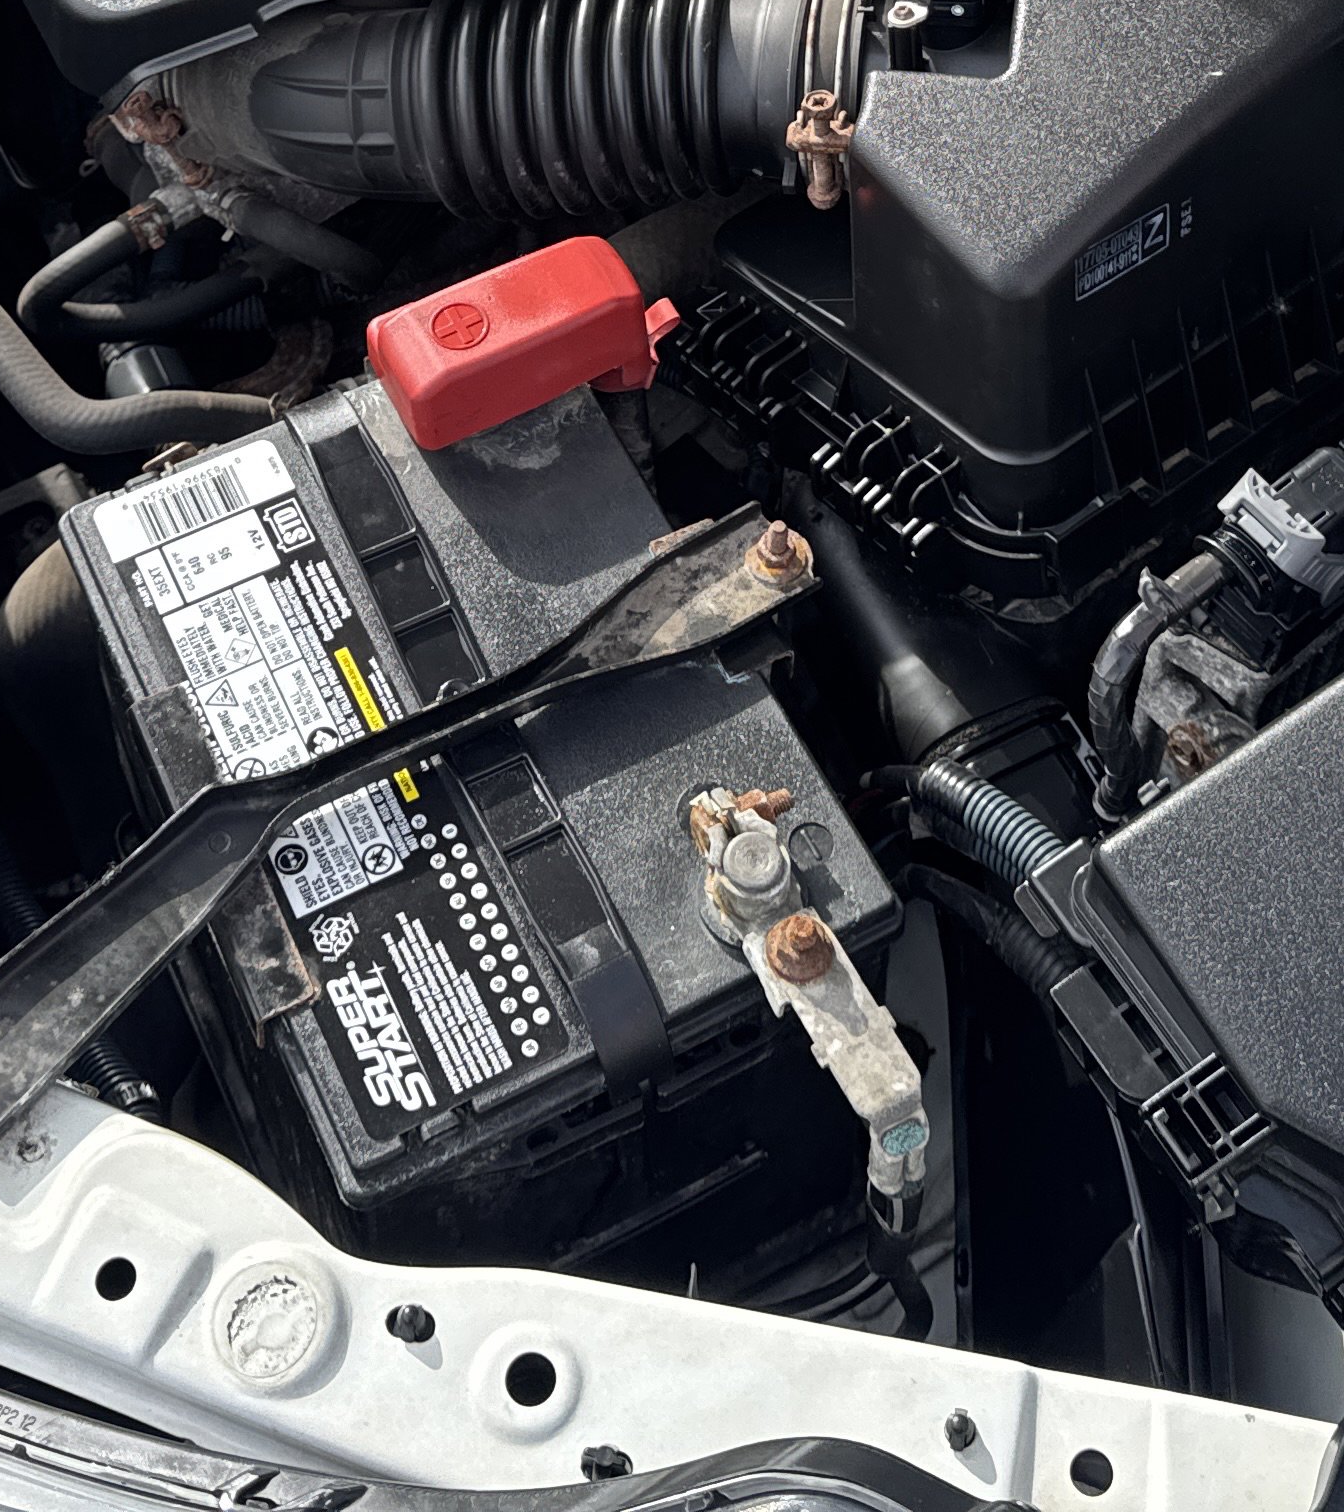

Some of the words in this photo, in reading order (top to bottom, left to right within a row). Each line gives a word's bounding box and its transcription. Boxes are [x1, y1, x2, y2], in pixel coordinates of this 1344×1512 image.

[1144, 213, 1164, 250] Z
[271, 503, 309, 547] STD
[247, 526, 265, 550] 12V
[217, 545, 233, 561] 95
[187, 554, 205, 576] 640
[147, 564, 171, 597] 35EXT
[181, 572, 196, 591] CCA
[198, 600, 213, 619] GET
[209, 596, 234, 633] MEDICAL
[231, 613, 249, 636] HELP
[255, 619, 271, 639] OPEN
[175, 635, 192, 658] EYES
[183, 624, 216, 680] IMMEDIATELY
[264, 638, 278, 654] NOT
[273, 633, 288, 650] NOT
[209, 651, 227, 674] WITH
[271, 653, 283, 665] DO
[281, 648, 293, 661] DO
[185, 657, 205, 685] FLUSH
[247, 682, 260, 695] OR
[289, 690, 303, 706] ALL
[241, 698, 260, 724] CAUSE
[253, 693, 278, 735] BLINDNESS
[269, 701, 290, 730] SEVERE
[295, 704, 312, 726] READ
[216, 708, 243, 751] SULFURIC
[238, 722, 256, 745] ACID
[252, 723, 267, 740] CAN
[354, 800, 367, 814] OF
[371, 791, 384, 804] OF
[377, 776, 412, 835] RECOMMENDED
[344, 805, 359, 825] OUT
[376, 800, 393, 822] RISK
[299, 816, 321, 846] GASES
[351, 822, 369, 845] KEEP
[359, 812, 379, 840] REACH
[404, 833, 419, 851] NOT
[328, 845, 347, 872] CAUSE
[312, 845, 343, 896] EXPLOSIVE
[340, 872, 355, 890] CAN
[352, 870, 365, 884] OR
[294, 874, 318, 908] SHIELD
[326, 976, 392, 1108] SUPER
[358, 974, 437, 1112] START
[19, 1414, 36, 1432] 12
